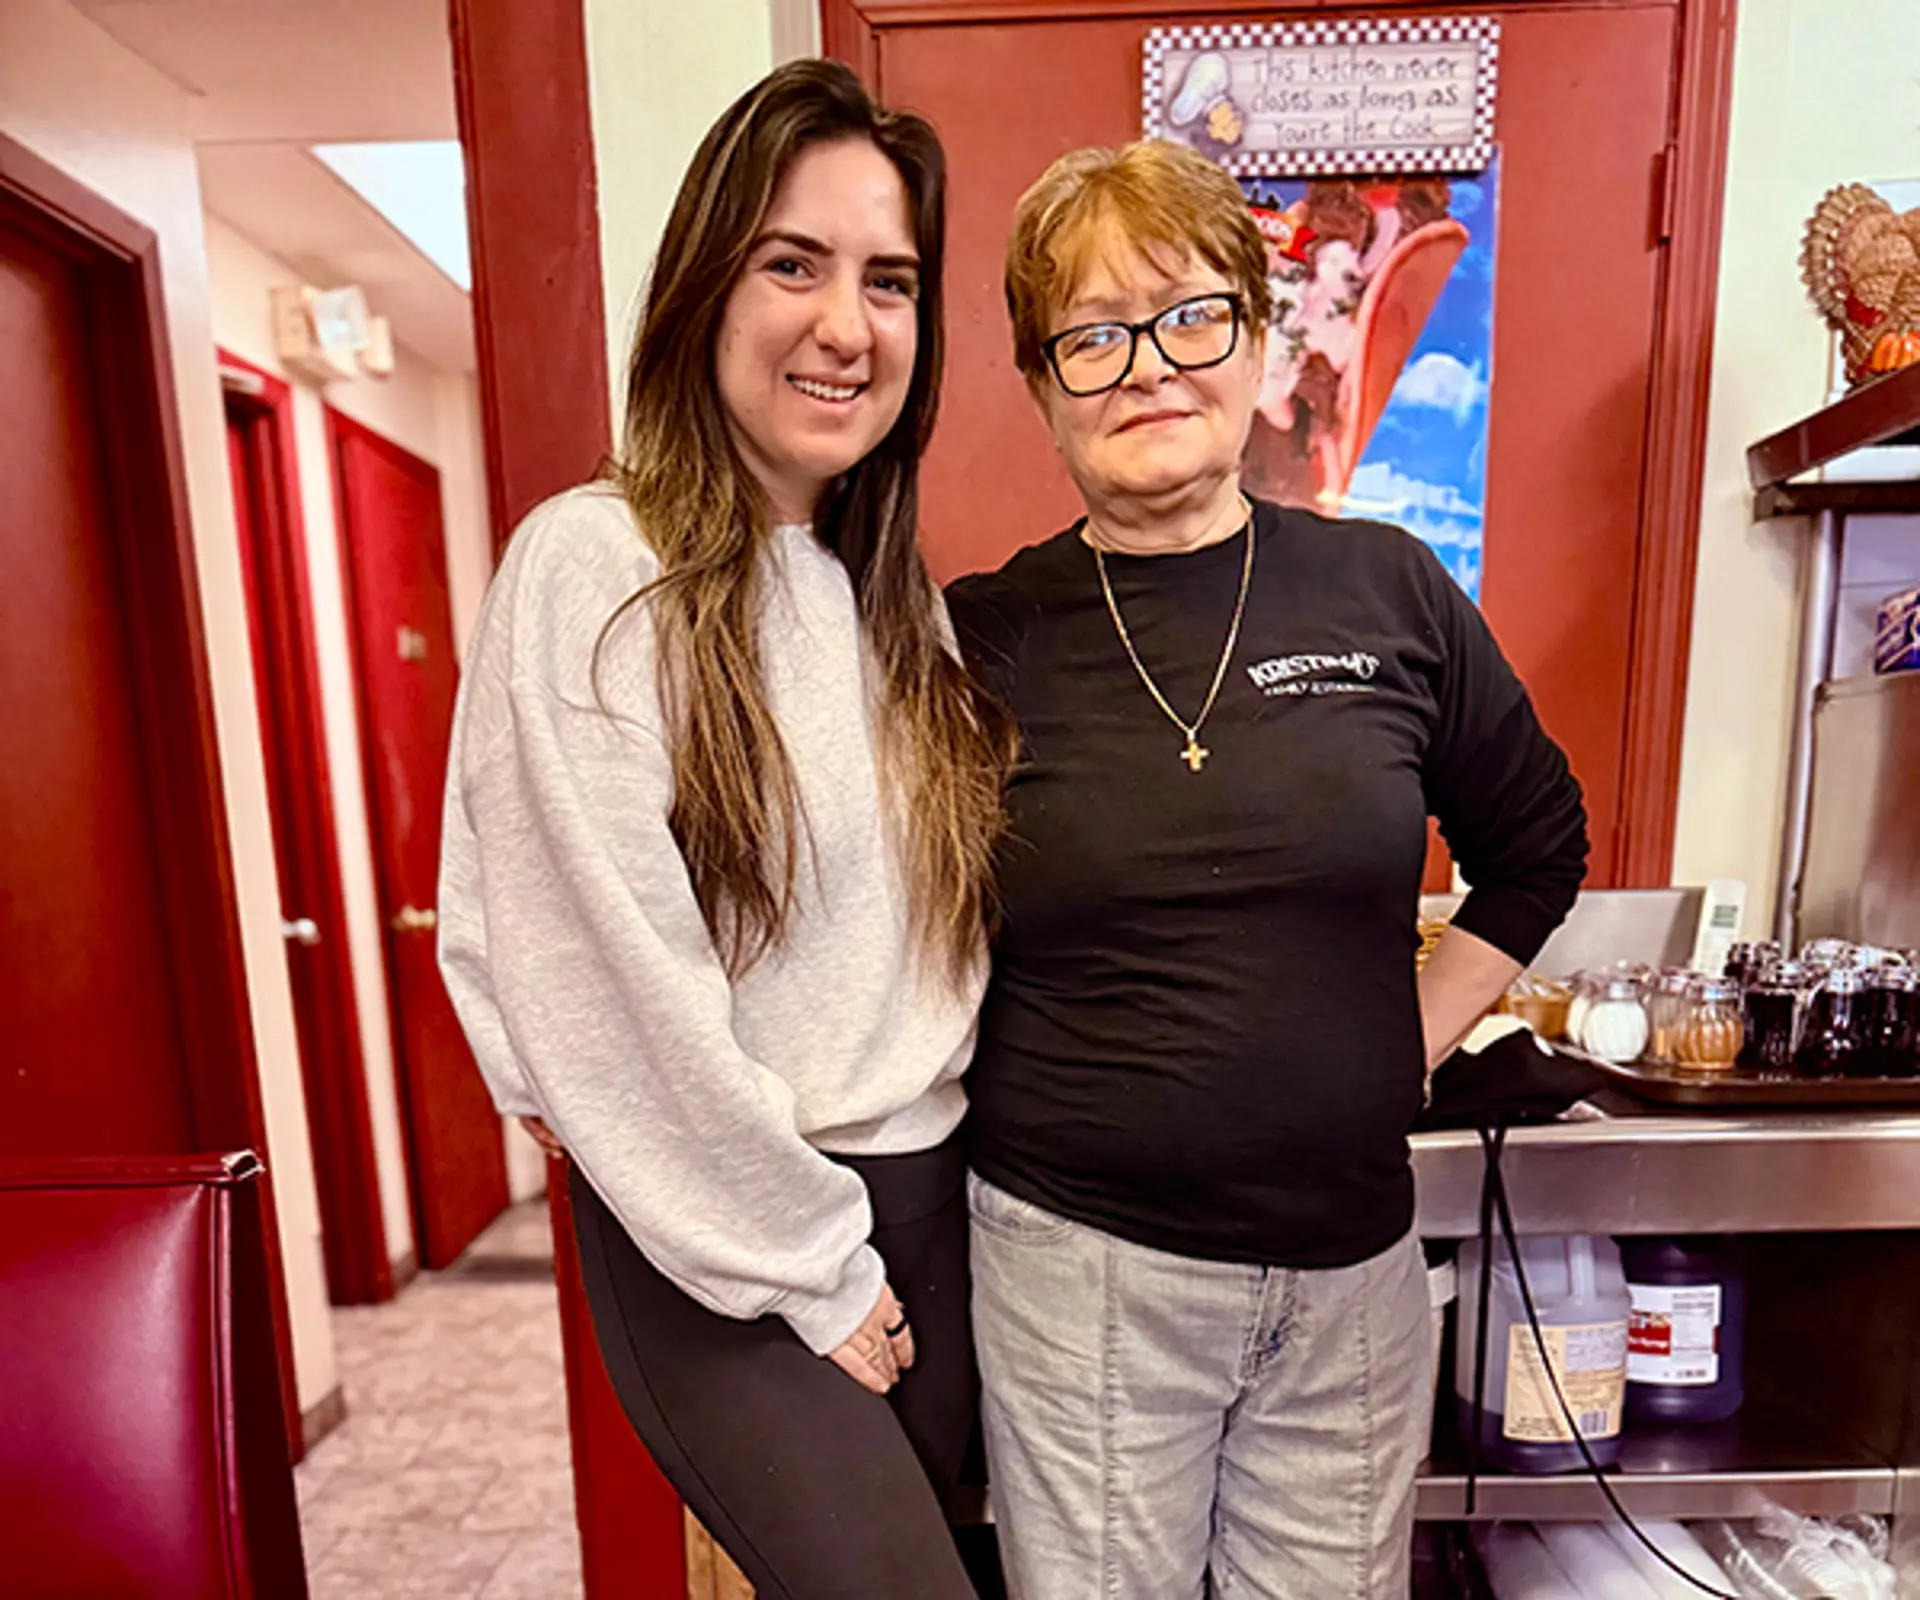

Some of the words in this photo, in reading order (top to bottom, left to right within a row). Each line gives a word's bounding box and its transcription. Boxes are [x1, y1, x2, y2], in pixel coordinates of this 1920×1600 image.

[1252, 52, 1296, 82] This
[1308, 50, 1386, 82] kitchen
[1394, 57, 1460, 80] never
[1251, 84, 1313, 112] closes
[1322, 91, 1350, 108] as
[1360, 84, 1416, 112] long
[1425, 83, 1459, 107] as
[1342, 109, 1376, 143] the
[1388, 112, 1438, 140] Cook
